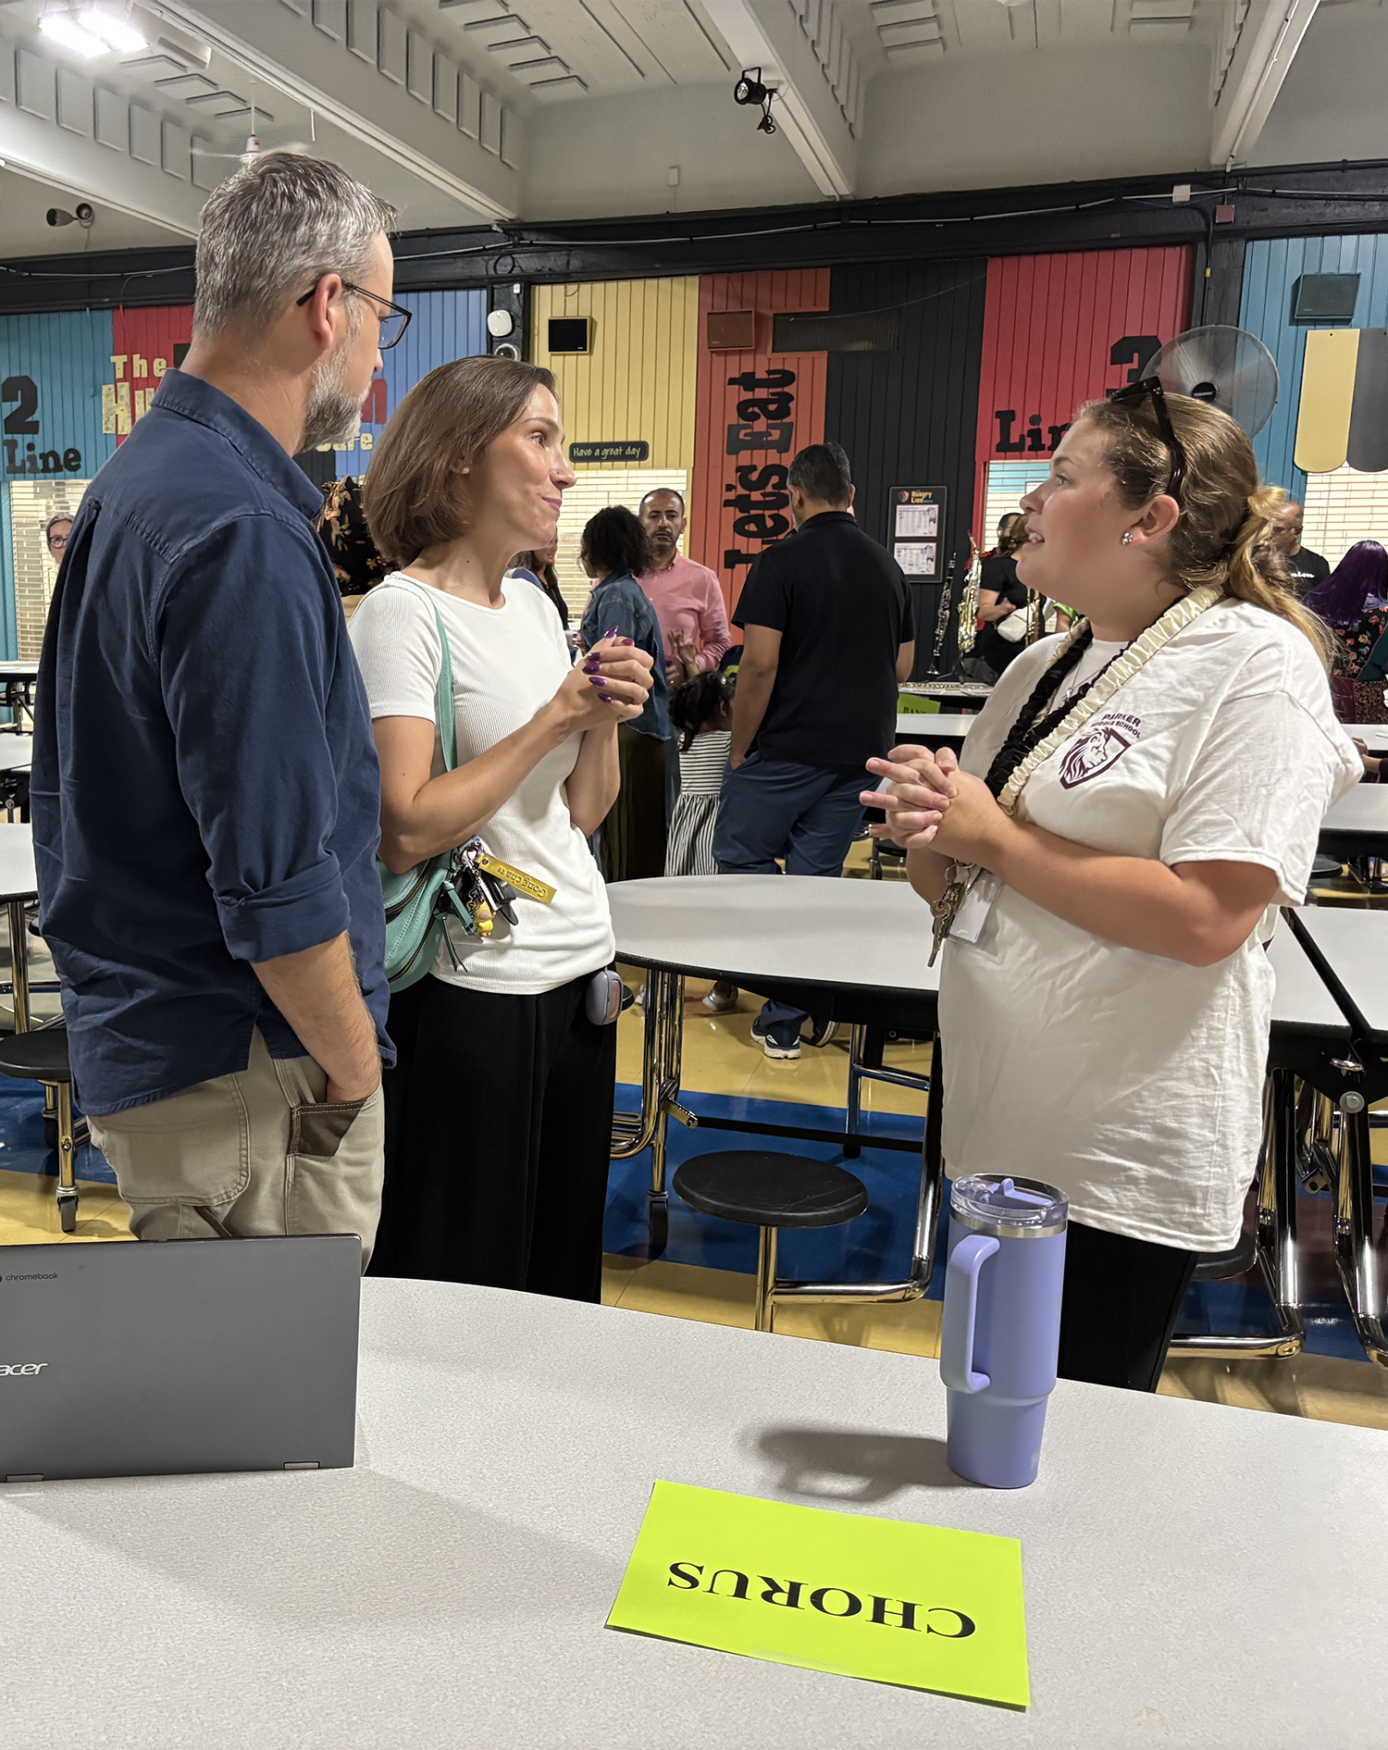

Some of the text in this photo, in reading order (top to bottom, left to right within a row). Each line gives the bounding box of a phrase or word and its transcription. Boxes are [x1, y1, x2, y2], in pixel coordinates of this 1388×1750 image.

[110, 354, 168, 379] The
[2, 375, 40, 435] 2
[726, 369, 796, 455] Eat
[995, 409, 1071, 453] Lin
[3, 439, 82, 474] Line
[573, 446, 641, 460] Have a great day
[5, 1272, 59, 1281] chromebook
[0, 1363, 48, 1376] acer
[667, 1561, 976, 1639] CHORUS
